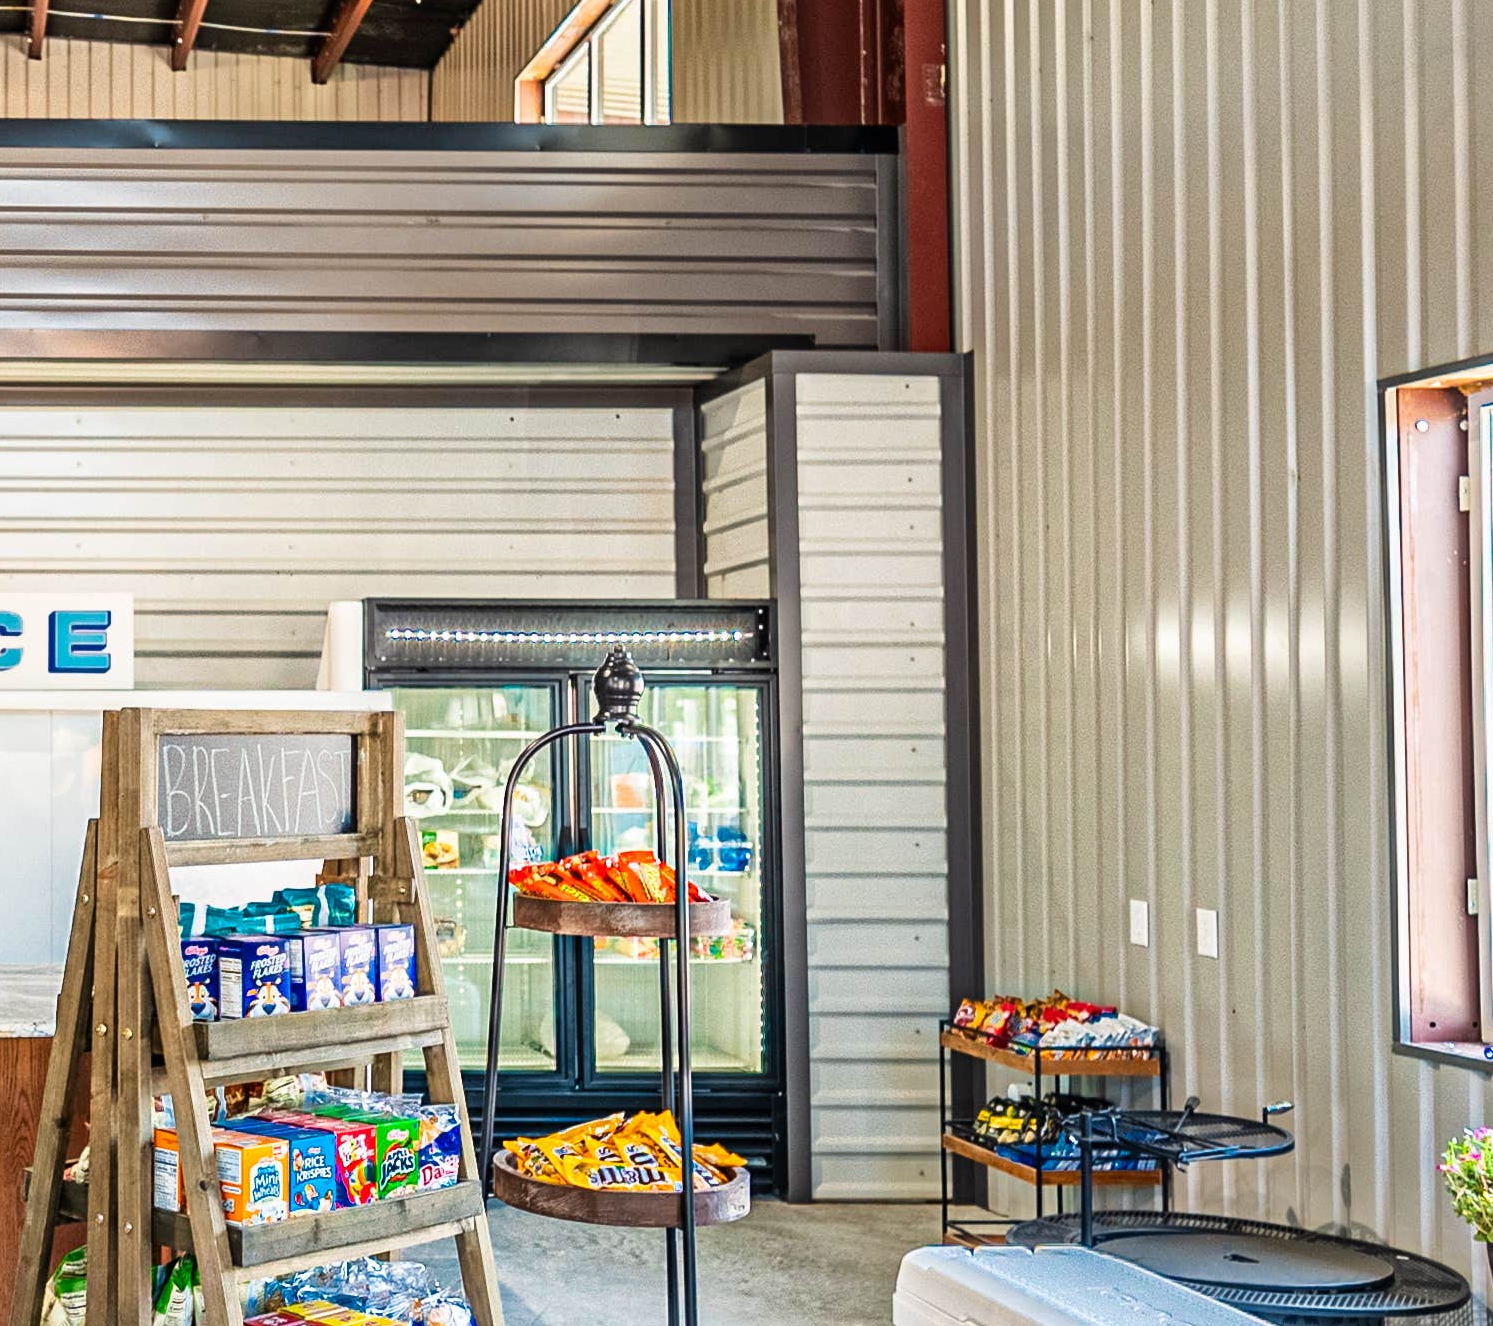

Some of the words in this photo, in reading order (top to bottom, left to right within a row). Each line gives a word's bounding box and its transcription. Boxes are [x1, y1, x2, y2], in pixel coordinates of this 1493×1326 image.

[161, 743, 352, 837] BREAKFAST
[183, 954, 217, 969] ROSTED
[250, 953, 287, 971] FROSTED
[183, 965, 214, 977] LAKES
[253, 964, 284, 980] FLAKES
[303, 1156, 325, 1170] RICE
[380, 1155, 415, 1187] JACKS
[254, 1172, 280, 1189] Mini
[296, 1166, 332, 1184] KRISPIES
[253, 1183, 281, 1202] Wheats
